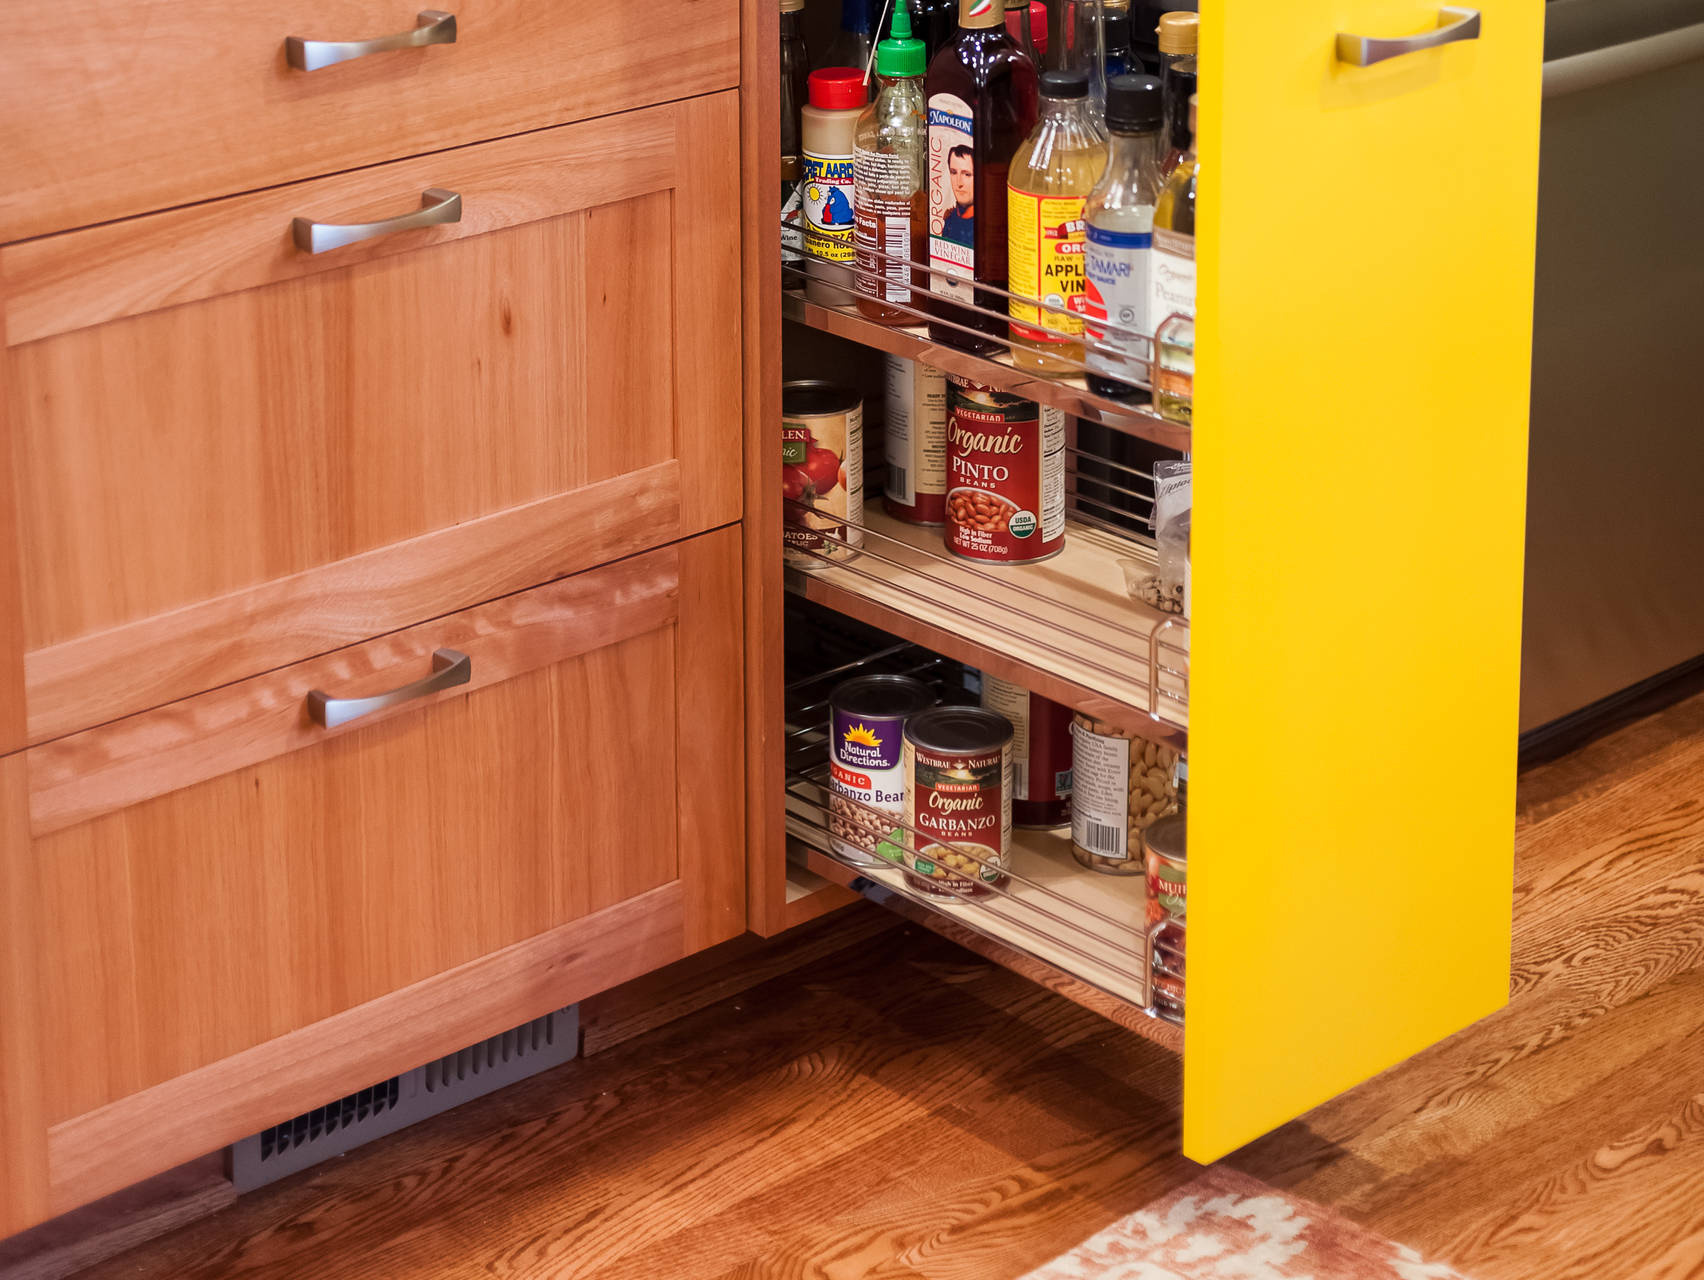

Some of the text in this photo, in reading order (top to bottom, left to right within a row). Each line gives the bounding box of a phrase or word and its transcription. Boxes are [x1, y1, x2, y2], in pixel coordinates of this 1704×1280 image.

[930, 110, 972, 132] NAPOLEON
[814, 177, 840, 185] Trading
[931, 136, 943, 236] ORGANIC
[934, 247, 971, 265] VINEGAR
[950, 244, 970, 257] WINE
[956, 407, 1001, 422] VEGETARIAN
[948, 417, 1023, 457] Organic
[952, 455, 1009, 481] PINTO
[960, 476, 996, 489] BEANS
[1015, 516, 1032, 524] USDA
[959, 525, 993, 539] High in Fiber
[959, 532, 993, 545] Low Sodium
[953, 536, 962, 545] NET
[962, 539, 970, 548] WT
[971, 542, 979, 551] 25
[979, 543, 988, 552] OZ
[840, 748, 890, 767] Directions.
[844, 741, 882, 758] Natural
[832, 767, 865, 785] GANIC
[831, 778, 871, 802] arbanzo
[928, 791, 984, 816] Organic
[919, 812, 996, 831] GARBANZO
